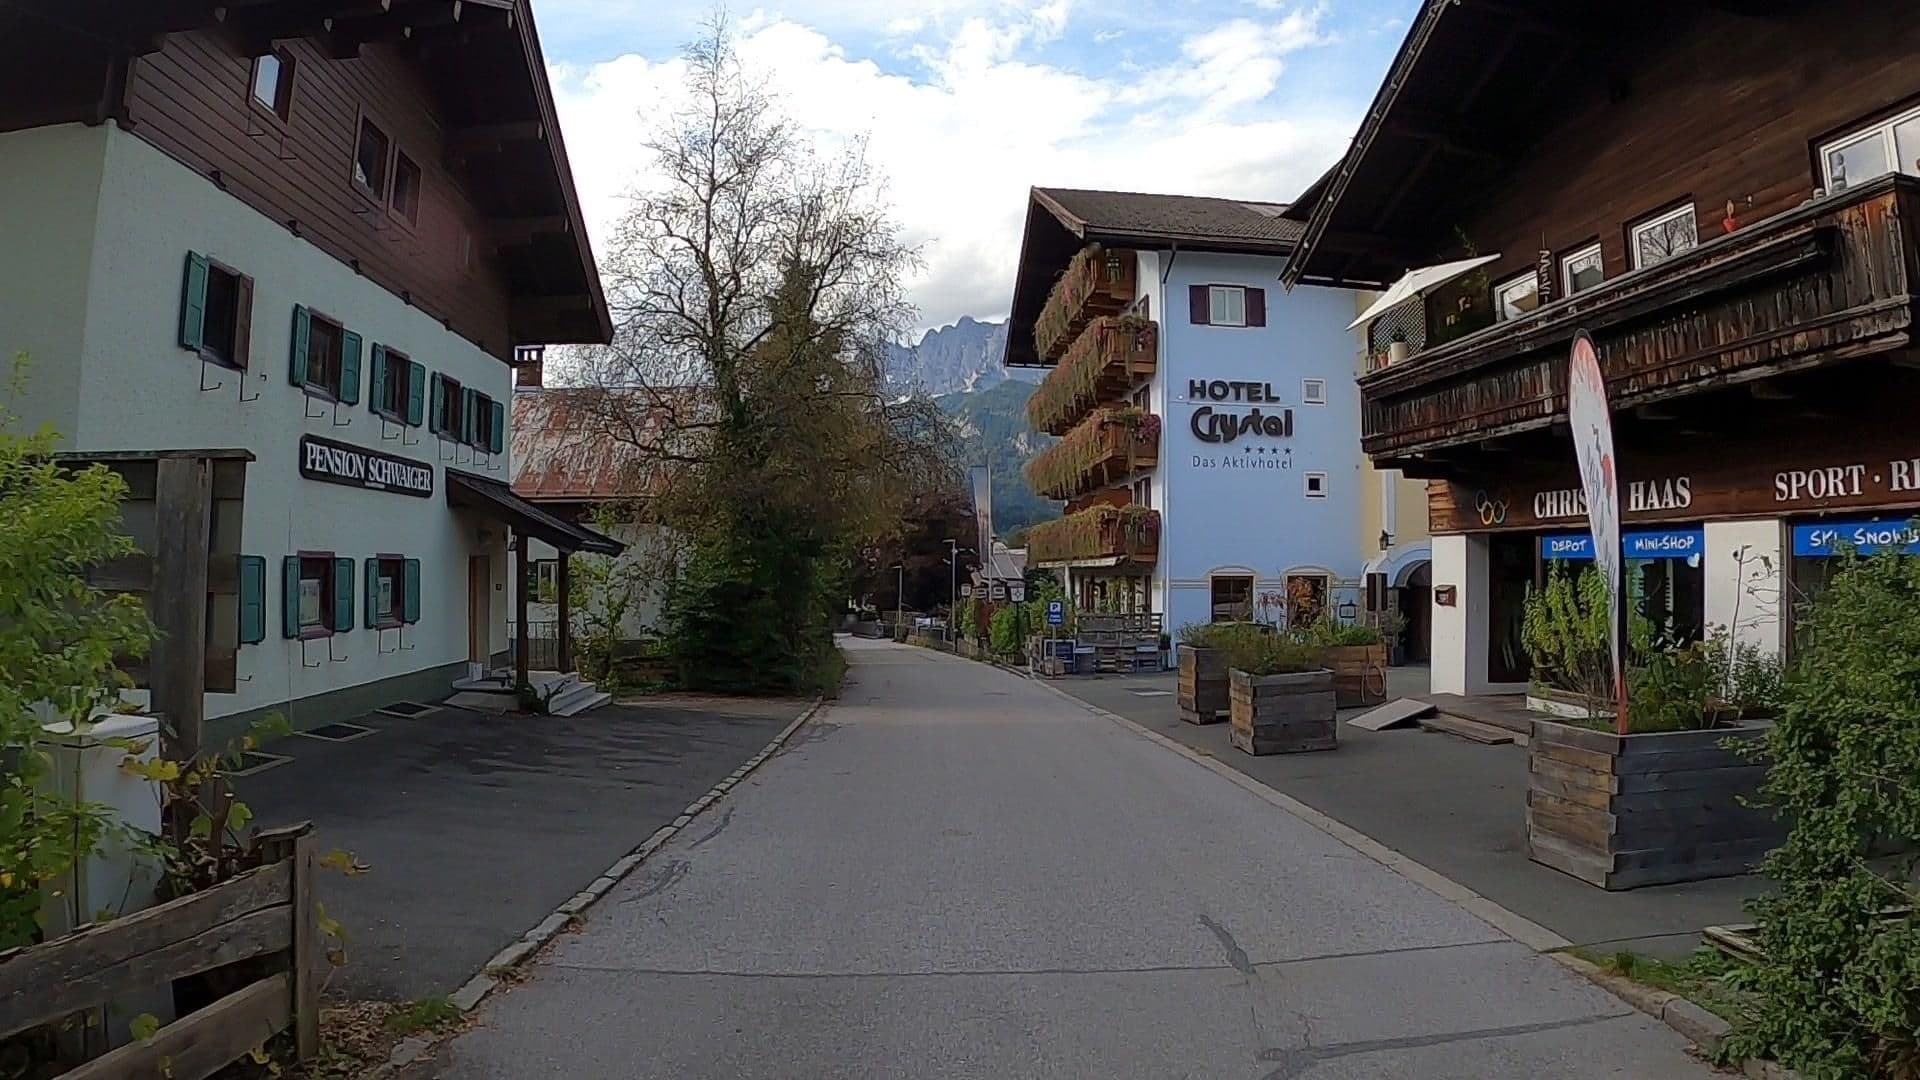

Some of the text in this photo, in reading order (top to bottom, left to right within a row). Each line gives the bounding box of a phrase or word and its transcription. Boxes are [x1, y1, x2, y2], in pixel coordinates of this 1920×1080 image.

[1189, 379, 1281, 403] HOTEL
[1190, 406, 1293, 443] Crystal
[305, 442, 432, 491] PENSION SCHWAIGER
[1192, 455, 1293, 469] Das Aktivhotel
[1534, 488, 1589, 519] CHRIS
[1628, 476, 1692, 512] HAAS
[1775, 464, 1866, 501] SPORT
[1551, 539, 1588, 552] DEPOT
[1635, 535, 1695, 551] MINI-SHOP
